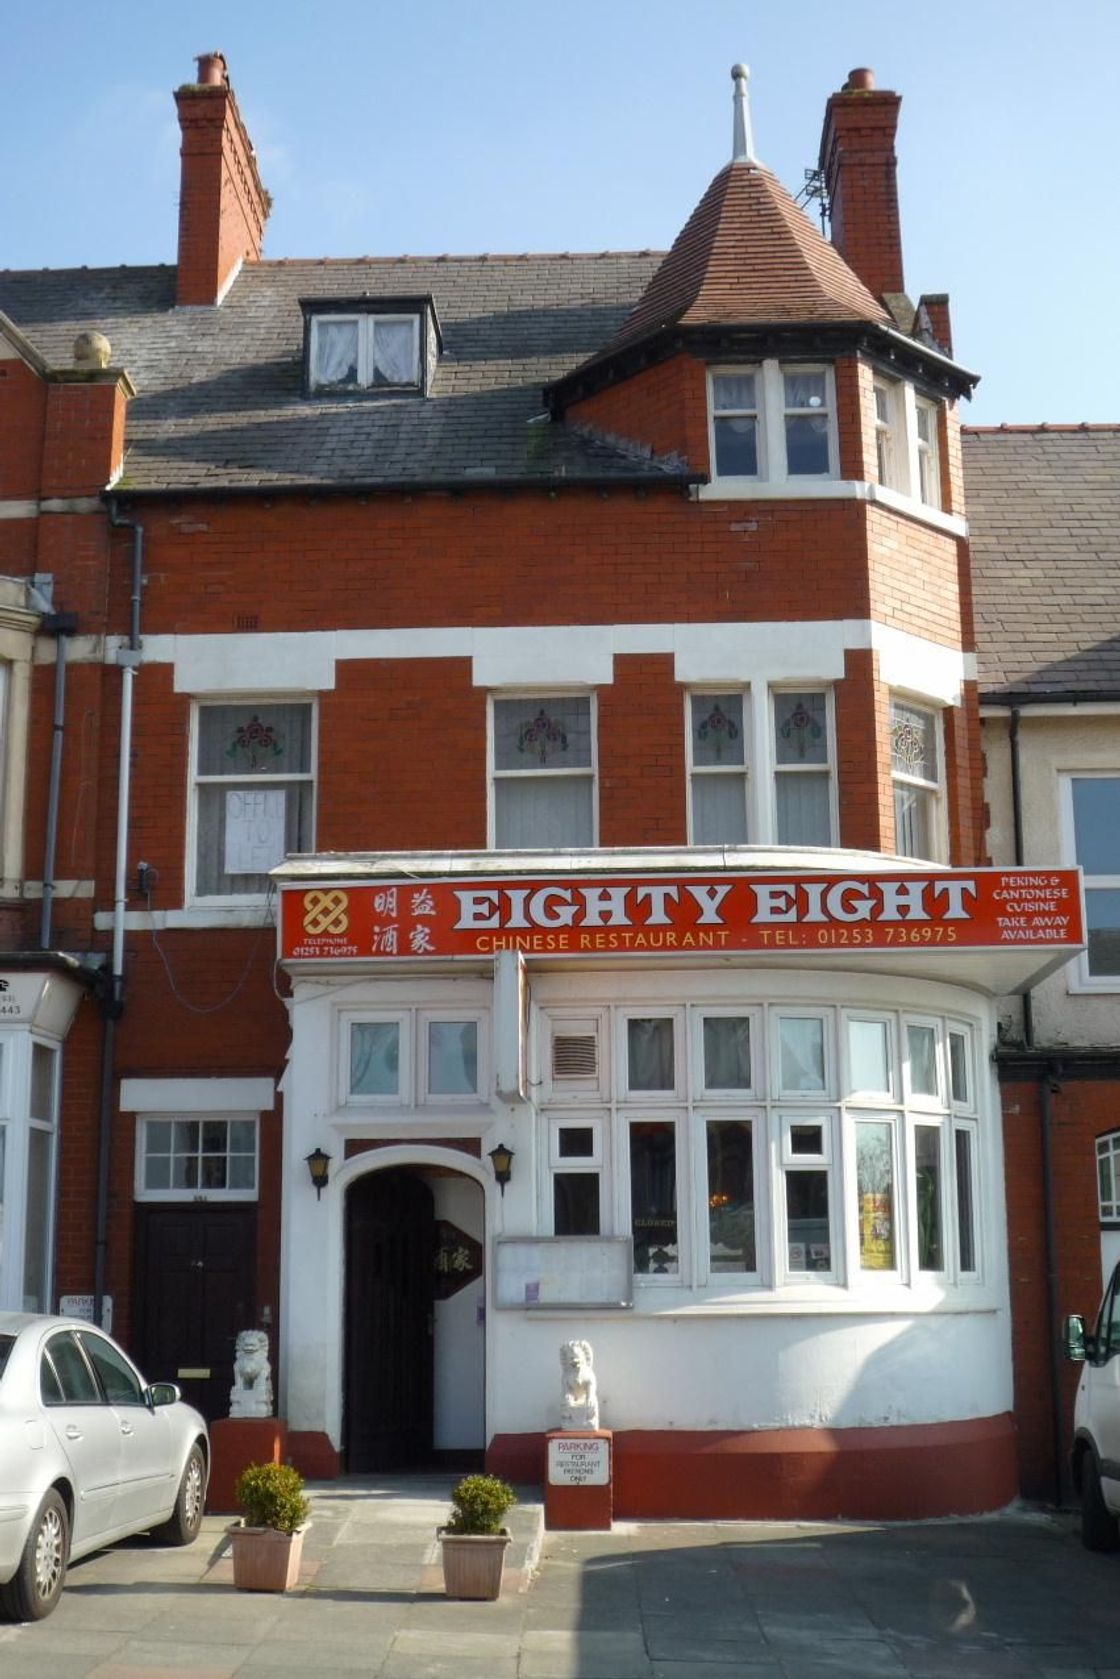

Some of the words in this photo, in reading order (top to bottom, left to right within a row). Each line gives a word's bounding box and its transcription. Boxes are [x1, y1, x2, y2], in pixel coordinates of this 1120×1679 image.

[1001, 876, 1047, 887] PEKING
[992, 888, 1070, 900] CANTONESE
[452, 885, 735, 929] EIGHTY
[749, 880, 977, 923] EIGHT
[1006, 901, 1058, 913] CUISINE
[996, 916, 1028, 927] TAKE
[1031, 915, 1070, 927] AWAY
[476, 933, 569, 951] CHINESE
[580, 931, 730, 949] RESTAURANT
[759, 930, 807, 946] TEL:
[817, 928, 874, 945] 01253
[885, 926, 957, 943] 736975
[1001, 928, 1068, 940] AVAILABLE
[558, 1442, 600, 1451] PARKING
